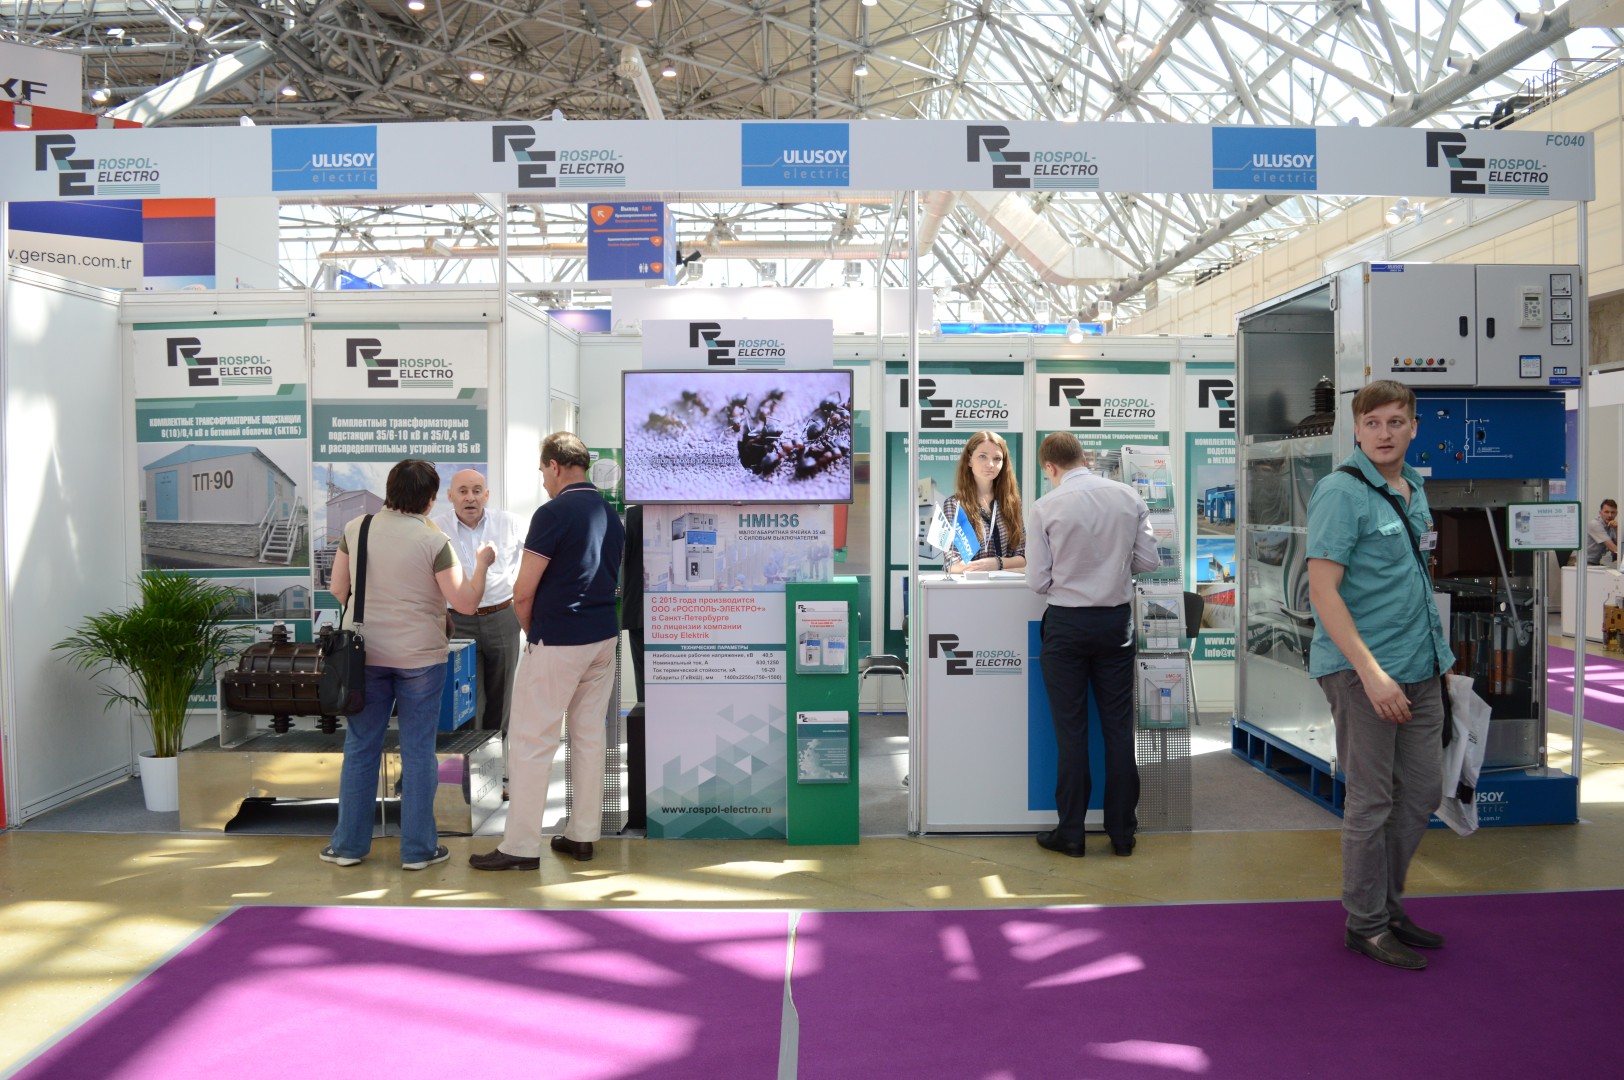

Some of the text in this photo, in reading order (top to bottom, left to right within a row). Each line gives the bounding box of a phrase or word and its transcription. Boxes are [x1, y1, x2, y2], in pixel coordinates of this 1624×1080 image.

[1545, 134, 1586, 147] FC040
[311, 153, 375, 168] ULUSOY
[559, 150, 623, 162] ROSPOL-
[783, 149, 848, 164] ULUSOY
[1034, 151, 1097, 163] ROSPOL-
[1252, 154, 1315, 168] ULUSOY
[98, 157, 158, 170] ROSPOL-
[559, 162, 625, 175] ELECTRO
[1488, 158, 1547, 170] ROSPOL-
[783, 168, 849, 179] electric
[1034, 164, 1099, 176] ELECTRO
[98, 170, 160, 183] ELECTRO
[312, 170, 376, 183] electric
[1253, 172, 1316, 184] electric
[1488, 170, 1549, 183] ELECTRO
[738, 339, 784, 348] ROSPOL-
[738, 348, 786, 357] ELECTRO
[219, 355, 271, 366] ROSPOL-
[399, 358, 453, 368] ROSPOL-
[219, 366, 272, 376] ELECTRO
[399, 369, 454, 379] ELECTRO
[955, 399, 1008, 409] ROSPOL-
[1103, 398, 1155, 408] ROSPOL-
[955, 409, 1009, 419] ELECTRO
[1103, 408, 1156, 418] ELECTRO
[149, 414, 302, 427] КОМПЛЕКТНЫЕ ТРАНСФОРМАТОРНЫЕ ПОДСТАНЦИИ
[331, 416, 469, 429] Комплектные трансформаторные
[194, 428, 204, 437] кВ
[210, 427, 241, 437] бетонной
[241, 426, 273, 436] оболочке
[328, 430, 470, 442] подстанции 35/6-10 кВ и 35/0,4 кВ
[320, 443, 481, 455] и распределительные устройства 35 кВ
[192, 470, 234, 491] ТП-90
[658, 615, 729, 623] Санкт-Петербурге
[663, 624, 702, 632] лицензии
[651, 632, 678, 640] Ulusoy
[975, 650, 1021, 659] ROSPOL-
[975, 658, 1022, 667] ELECTRO
[661, 804, 772, 815] www.rospol-electro.ru
